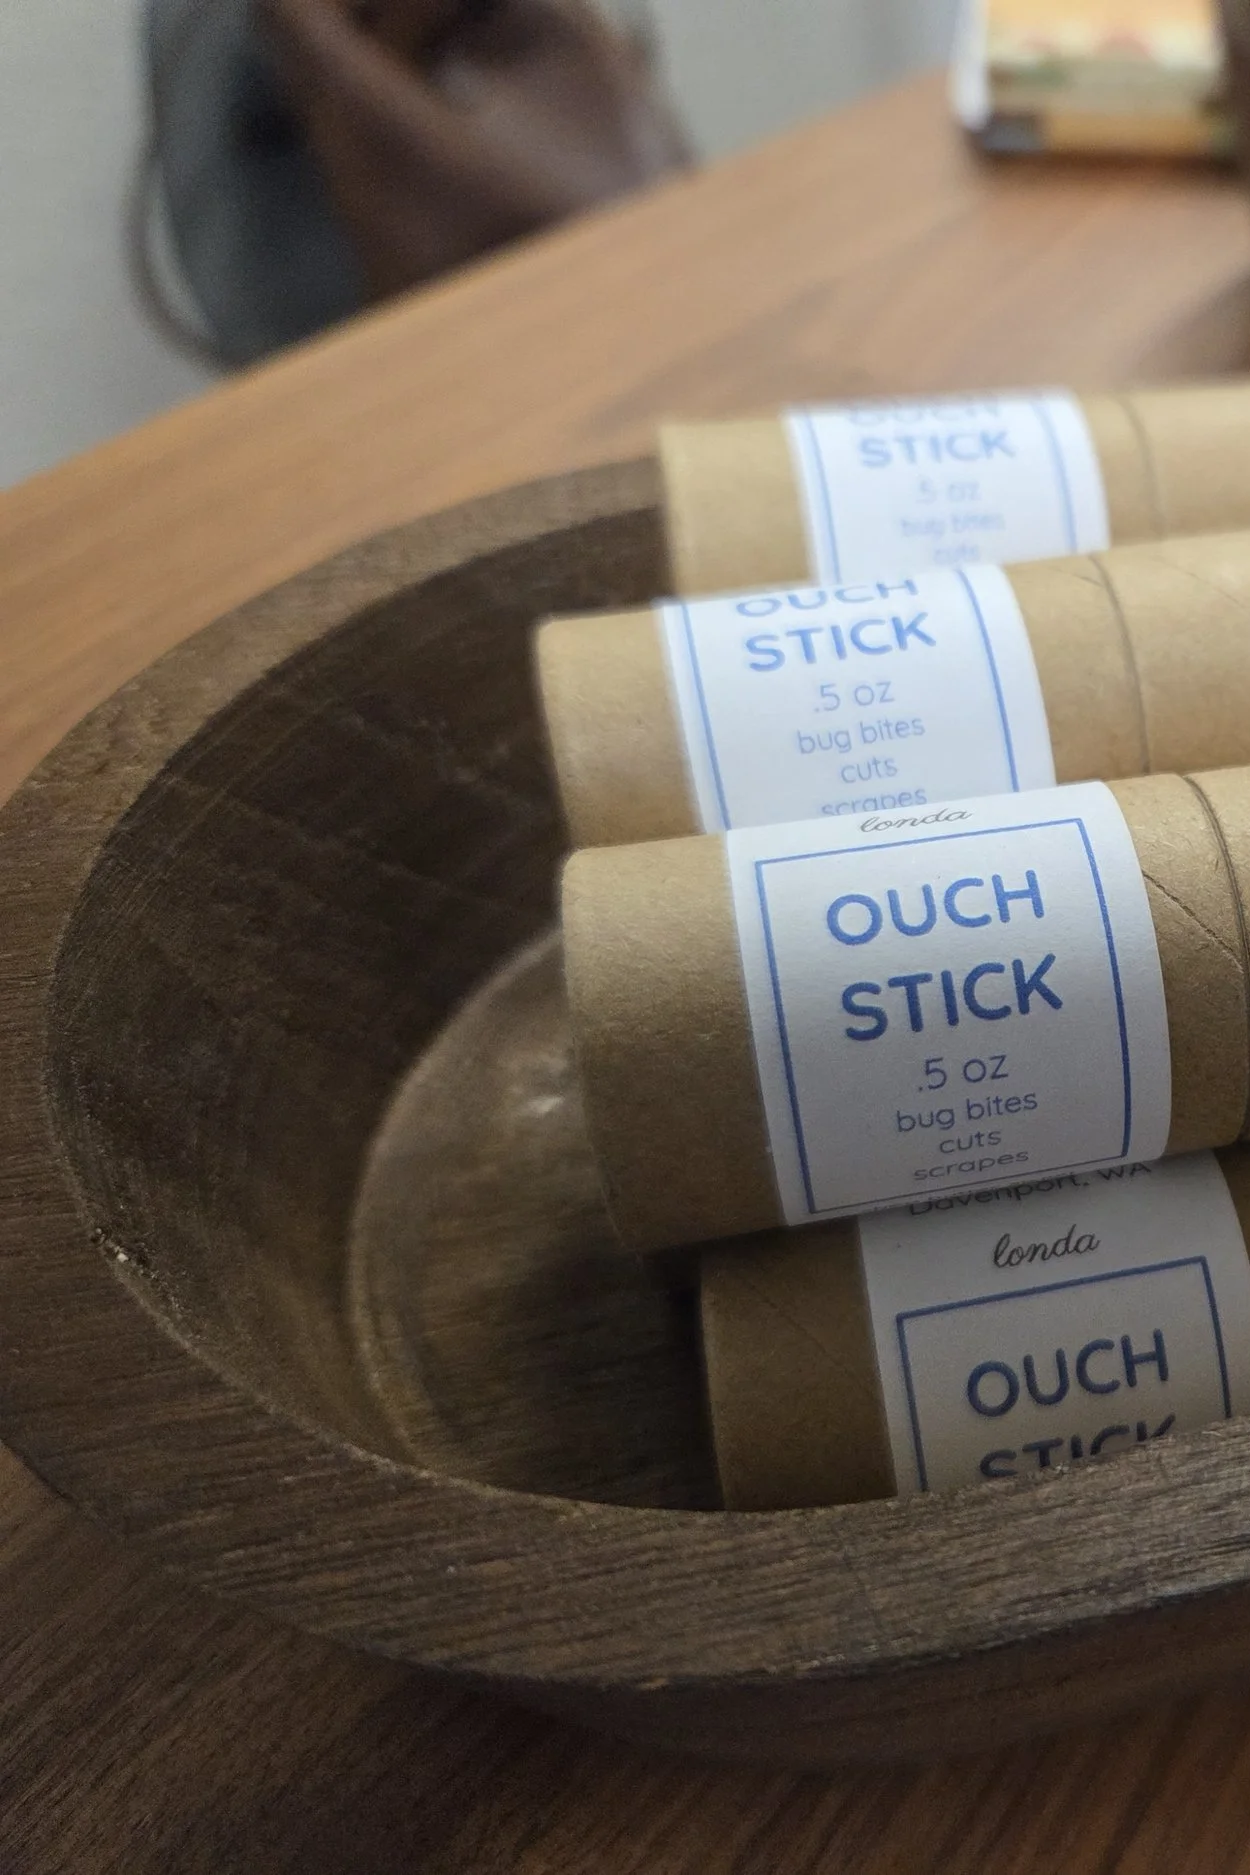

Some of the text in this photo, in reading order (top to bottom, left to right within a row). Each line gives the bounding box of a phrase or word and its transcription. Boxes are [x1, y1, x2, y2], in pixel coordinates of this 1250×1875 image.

[857, 429, 1016, 469] STICK
[736, 578, 918, 618] OUCH
[744, 611, 937, 672] STICK
[813, 680, 895, 713] .5 oz
[796, 715, 926, 755] bug bites
[840, 756, 898, 784] cuts
[820, 787, 928, 817] scrapes
[860, 808, 973, 833] londa
[826, 869, 1044, 946] OUCH
[840, 953, 1063, 1041] STICK
[916, 1055, 1009, 1092] .5 oz
[896, 1091, 1038, 1133] bug bites
[939, 1129, 1001, 1155] cuts
[913, 1149, 1030, 1181] scrapes
[1097, 1161, 1152, 1181] WA
[993, 1224, 1100, 1269] londa
[966, 1328, 1169, 1417] OUCH
